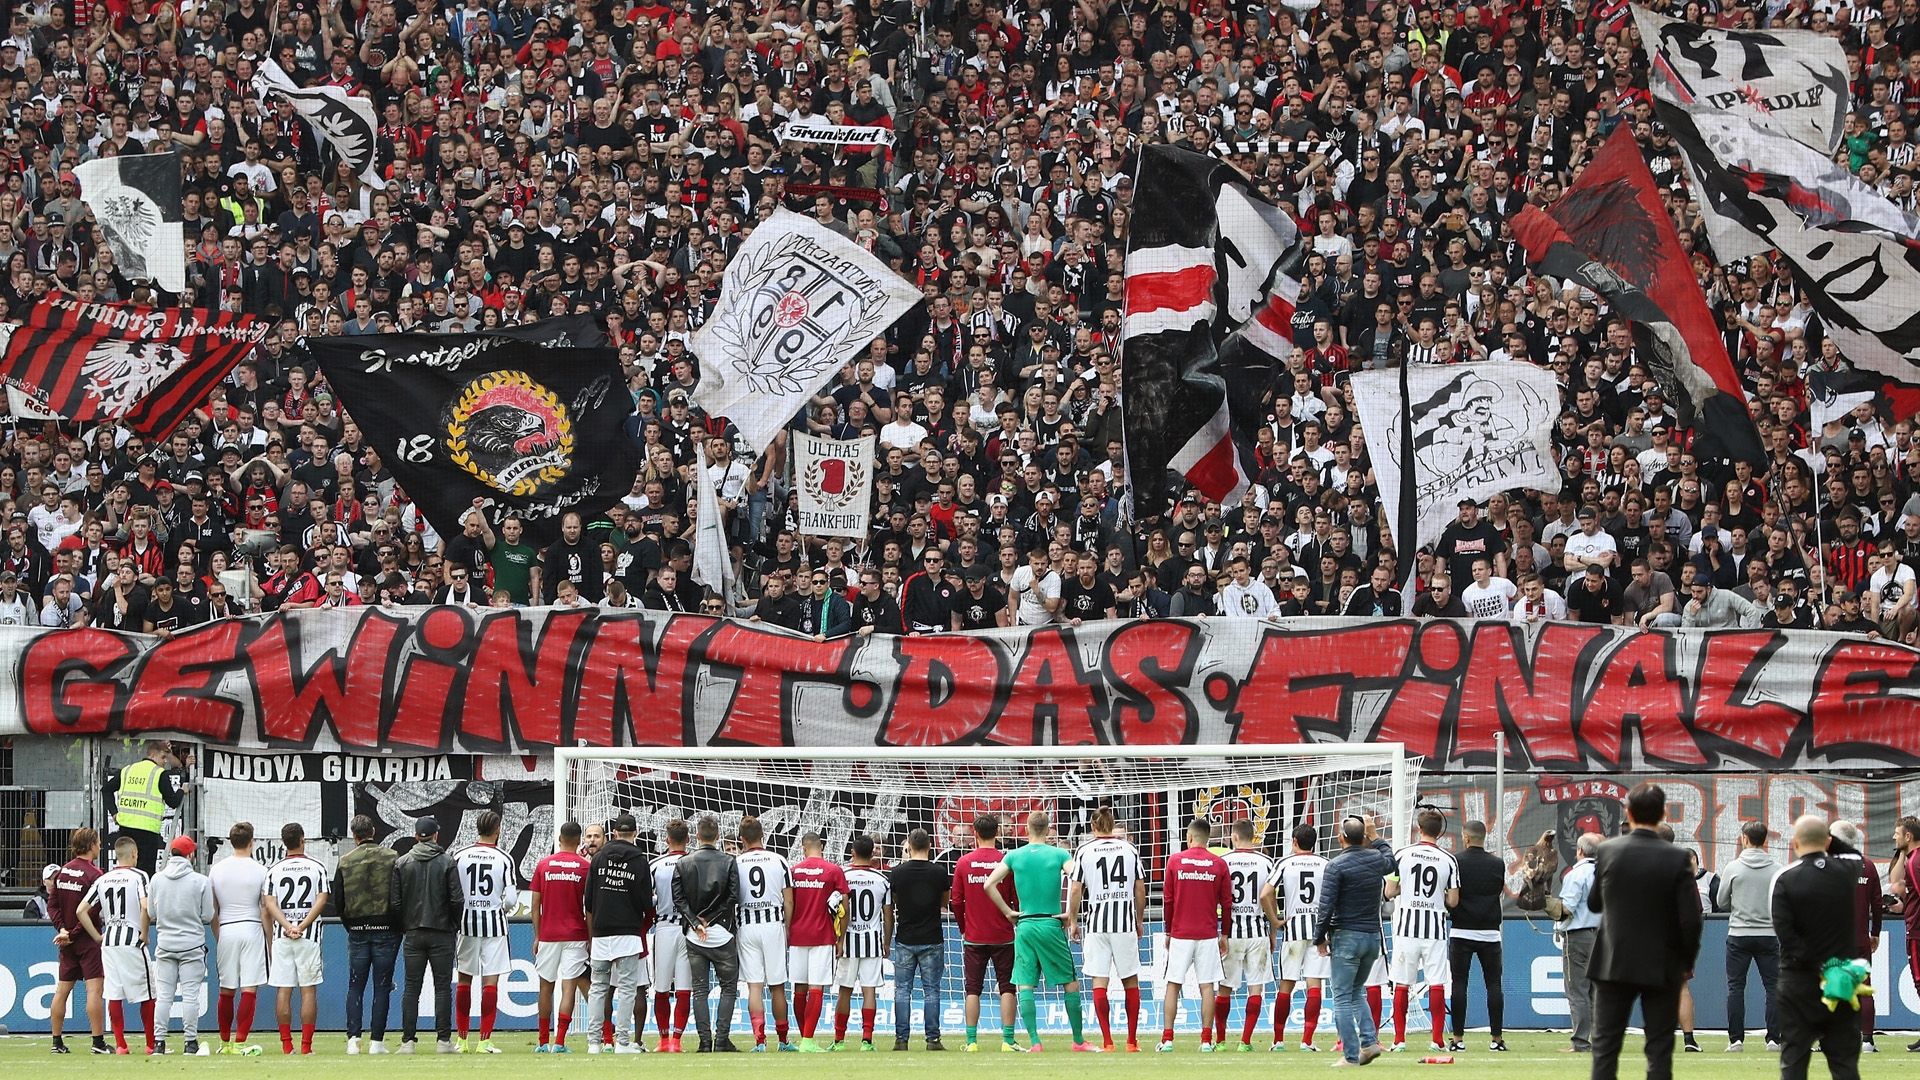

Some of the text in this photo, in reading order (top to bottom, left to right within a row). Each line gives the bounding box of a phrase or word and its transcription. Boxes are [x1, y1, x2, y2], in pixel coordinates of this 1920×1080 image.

[789, 125, 880, 143] Frankfurt
[25, 397, 51, 416] Red
[396, 433, 436, 463] 18
[807, 440, 860, 458] ULTRAS
[800, 511, 862, 530] FRANKFURT
[876, 619, 1201, 748] DAS
[212, 753, 306, 782] NUOVA
[322, 754, 452, 783] GUARDIA
[127, 776, 146, 786] 35047
[119, 797, 148, 809] ECURITY
[1094, 845, 1123, 853] Eintracht
[1411, 852, 1440, 862] Eintracht
[466, 862, 493, 896] 15
[545, 871, 582, 883] Krombacher
[598, 868, 636, 881] EX MACHINA
[1096, 854, 1128, 890] 14
[1177, 869, 1216, 882] Krombacher
[1410, 863, 1438, 898] 19
[605, 877, 625, 887] VENICE
[748, 865, 766, 899] 9
[1231, 870, 1258, 905] 31
[1299, 871, 1315, 905] 5
[280, 875, 312, 909] 22
[1111, 891, 1129, 900] MEIER
[105, 886, 127, 919] 11
[468, 899, 492, 908] HECTOR
[848, 888, 875, 922] 10
